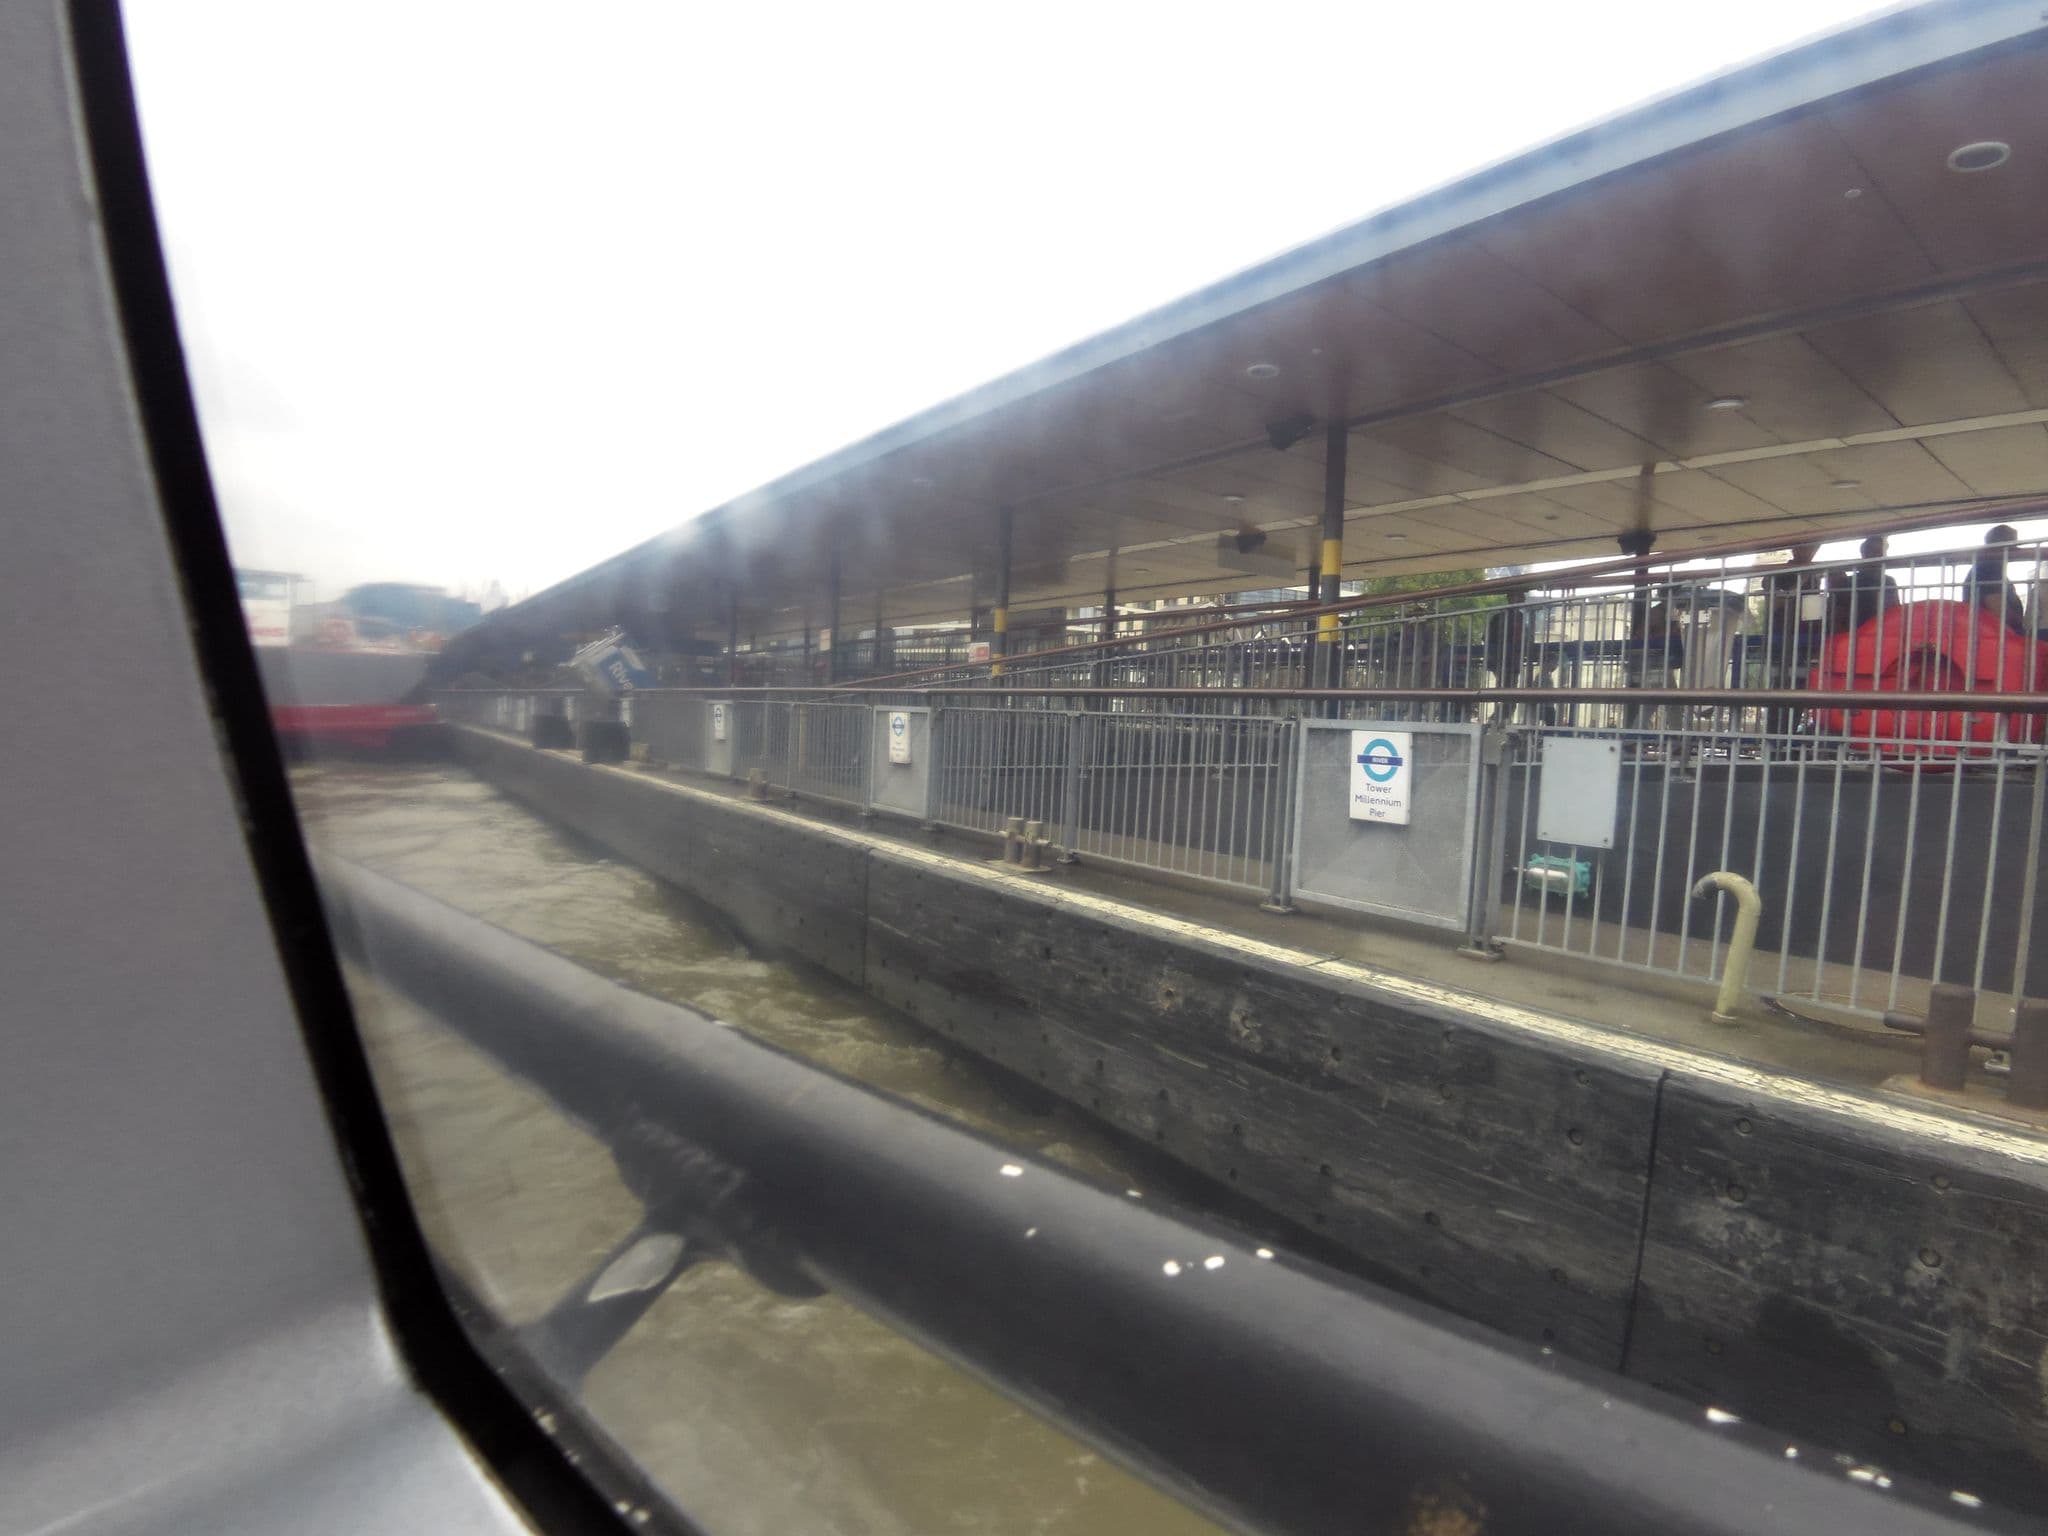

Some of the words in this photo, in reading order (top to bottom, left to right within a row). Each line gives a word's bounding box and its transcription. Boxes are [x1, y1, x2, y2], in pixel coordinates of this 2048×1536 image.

[1366, 783, 1392, 794] Tower
[1355, 794, 1402, 807] Millennium
[1369, 807, 1386, 818] Pier
